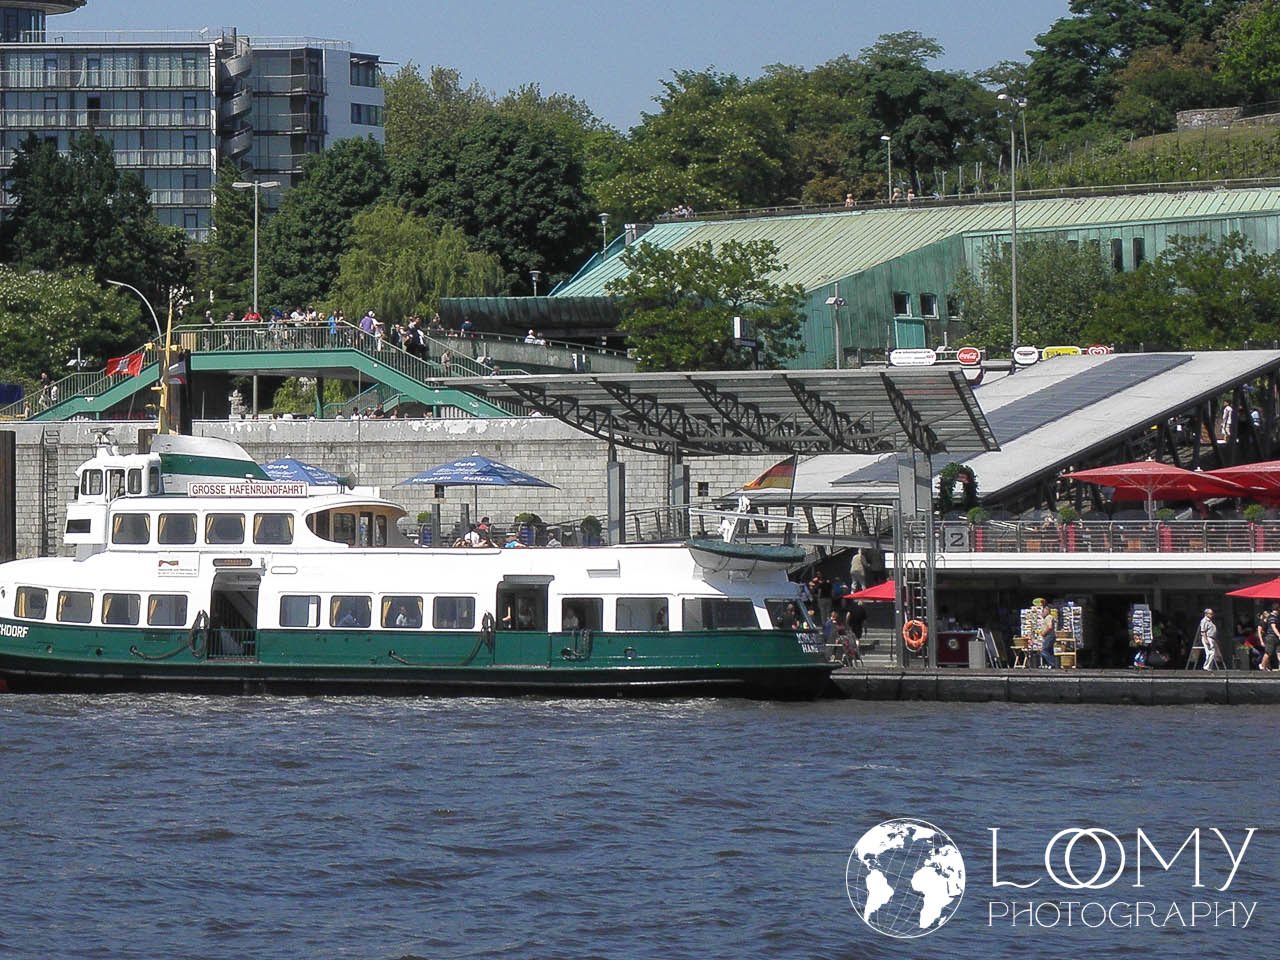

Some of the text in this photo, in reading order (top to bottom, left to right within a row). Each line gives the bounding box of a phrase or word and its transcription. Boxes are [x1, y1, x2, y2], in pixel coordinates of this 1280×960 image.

[192, 484, 304, 495] GROSSE HAFENRUNDFAHRT
[950, 532, 965, 547] 2
